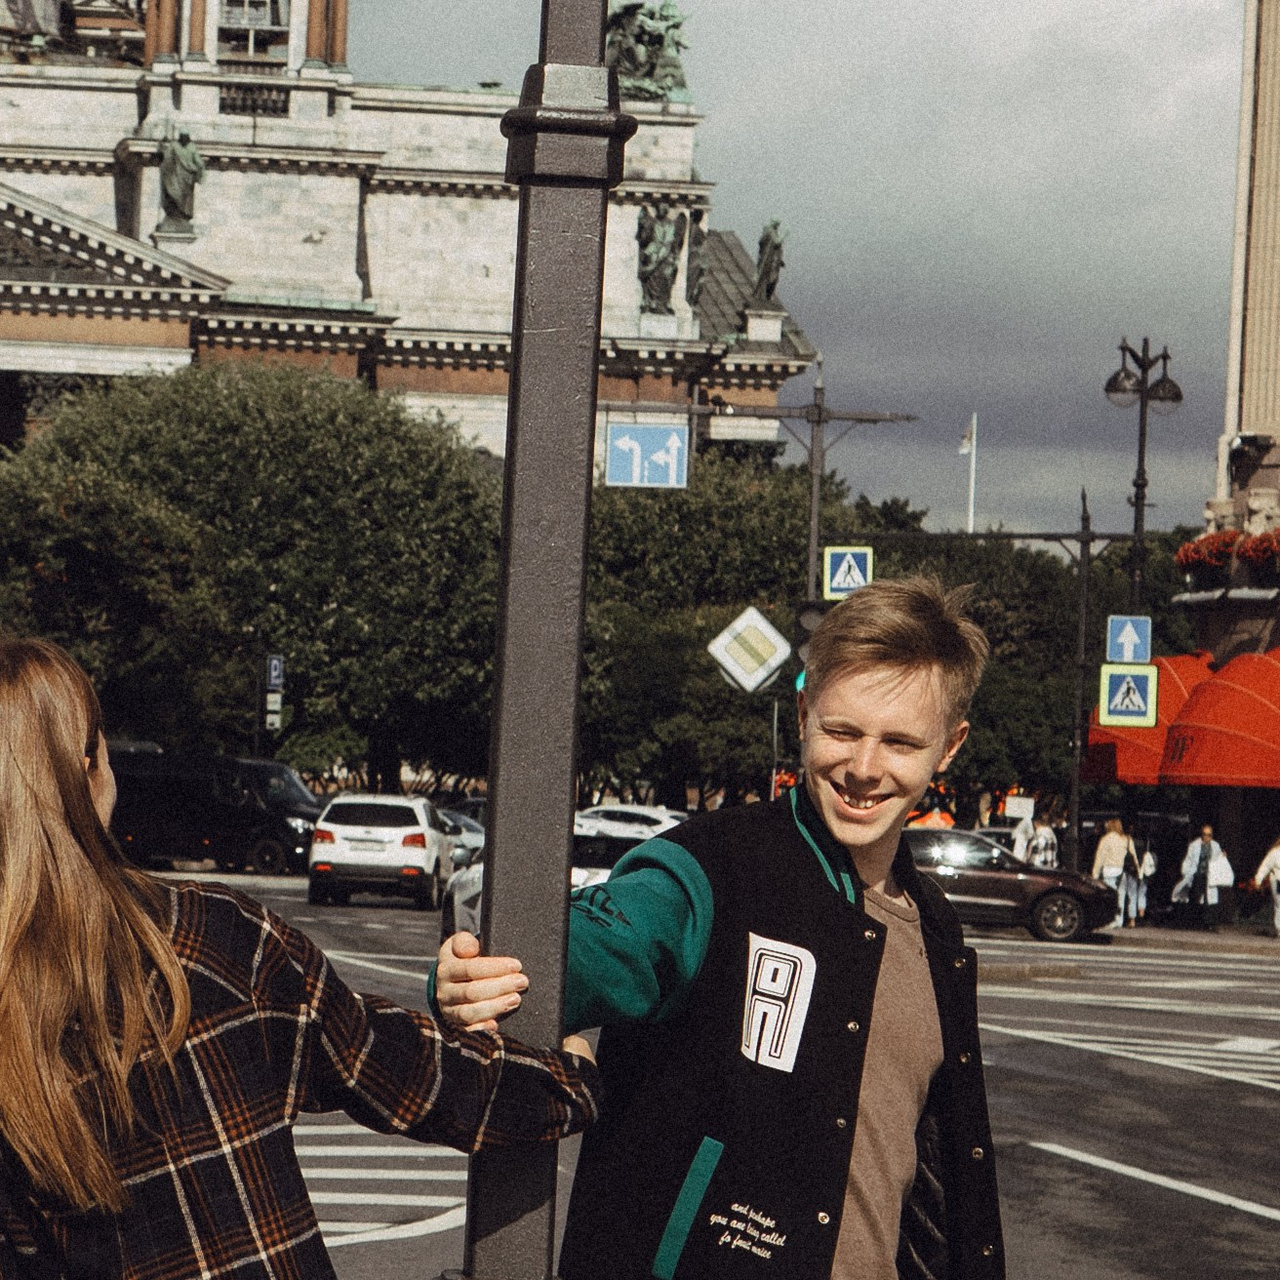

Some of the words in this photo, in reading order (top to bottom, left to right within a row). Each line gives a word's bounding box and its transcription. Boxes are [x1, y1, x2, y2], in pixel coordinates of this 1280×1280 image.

[731, 1203, 750, 1215] and
[710, 1214, 728, 1225] you
[730, 1219, 746, 1231] are
[760, 1231, 787, 1247] called
